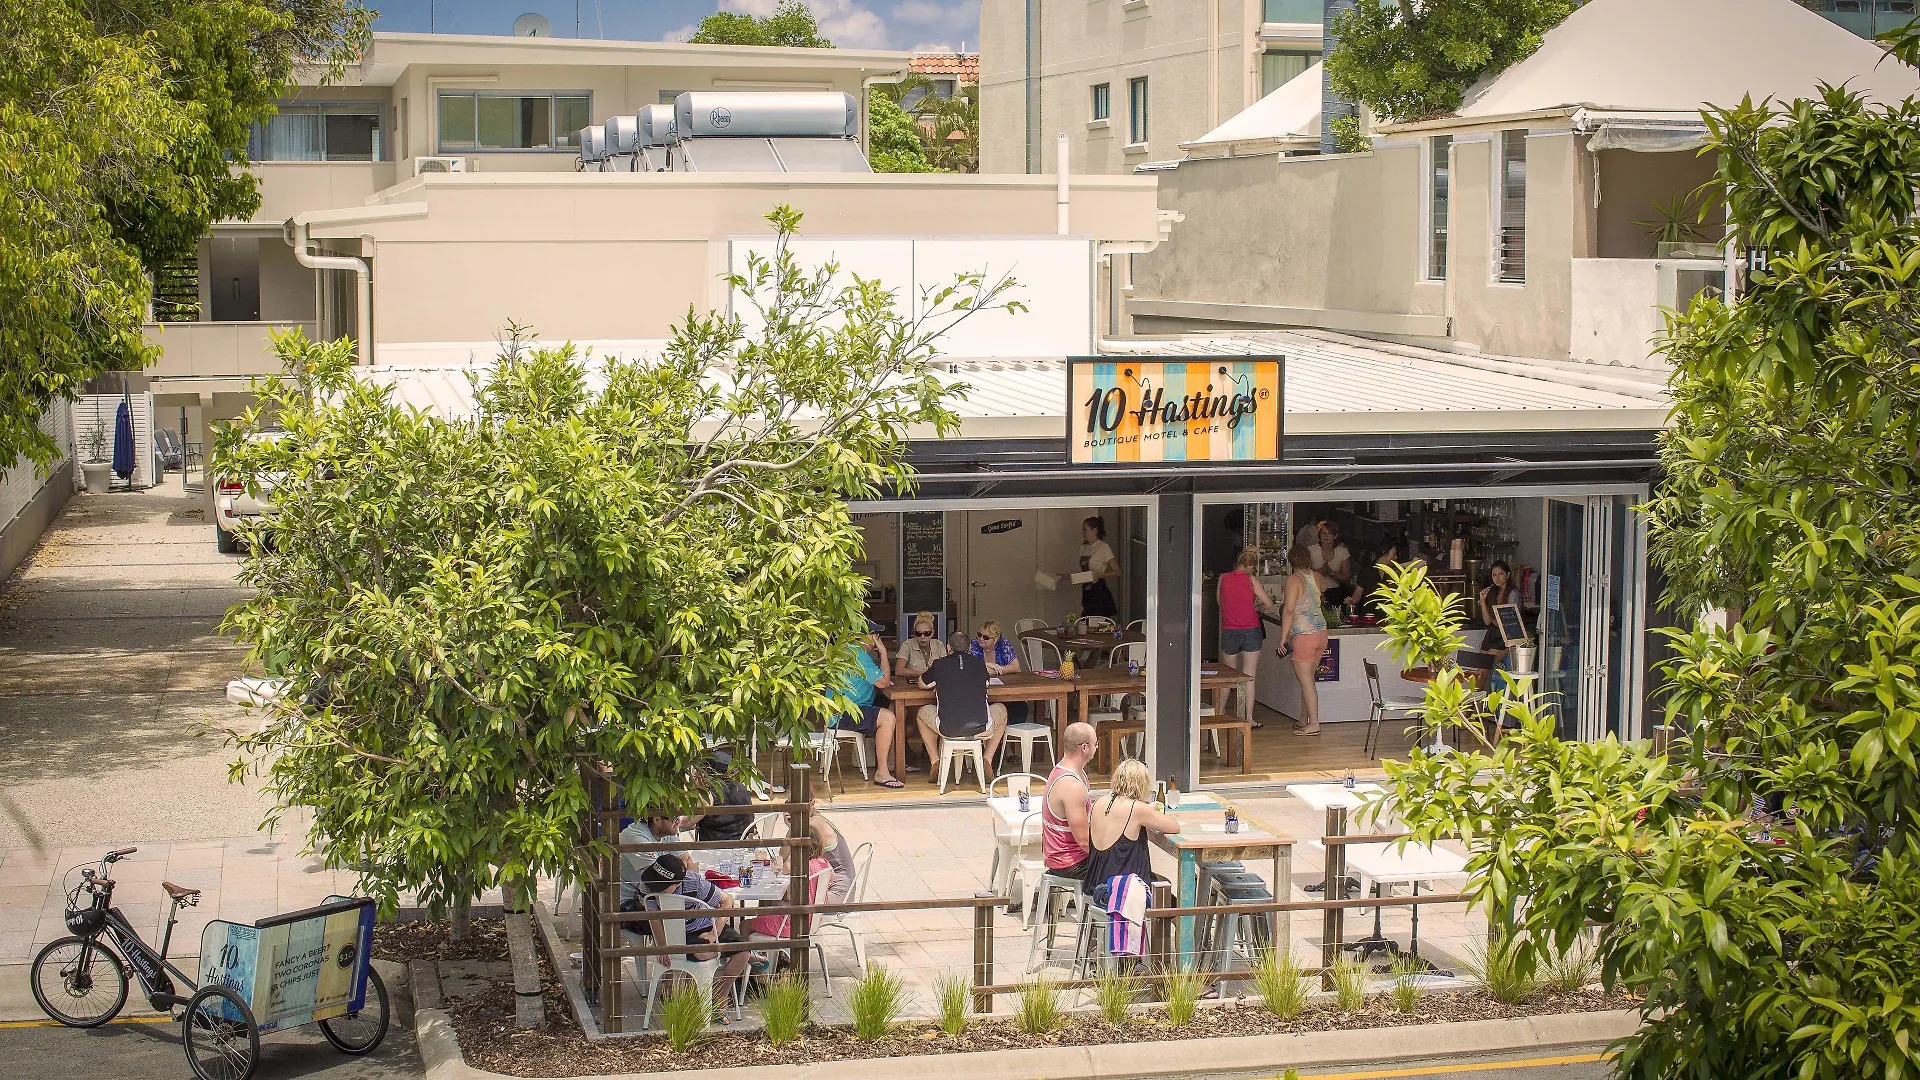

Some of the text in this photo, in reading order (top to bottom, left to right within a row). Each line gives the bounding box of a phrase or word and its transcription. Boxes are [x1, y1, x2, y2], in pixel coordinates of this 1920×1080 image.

[1085, 384, 1257, 433] 10 Hastings
[1083, 425, 1220, 448] BOUTIQUE MOTEL & CAFE
[121, 937, 157, 979] 10 Hastings
[220, 944, 239, 969] 10
[274, 954, 330, 980] TWO CORONAS
[275, 943, 331, 969] FANCY A BEER?
[339, 950, 354, 963] $10
[206, 966, 244, 993] Hastings
[279, 975, 301, 989] CHIPS
[301, 968, 320, 981] JUST
